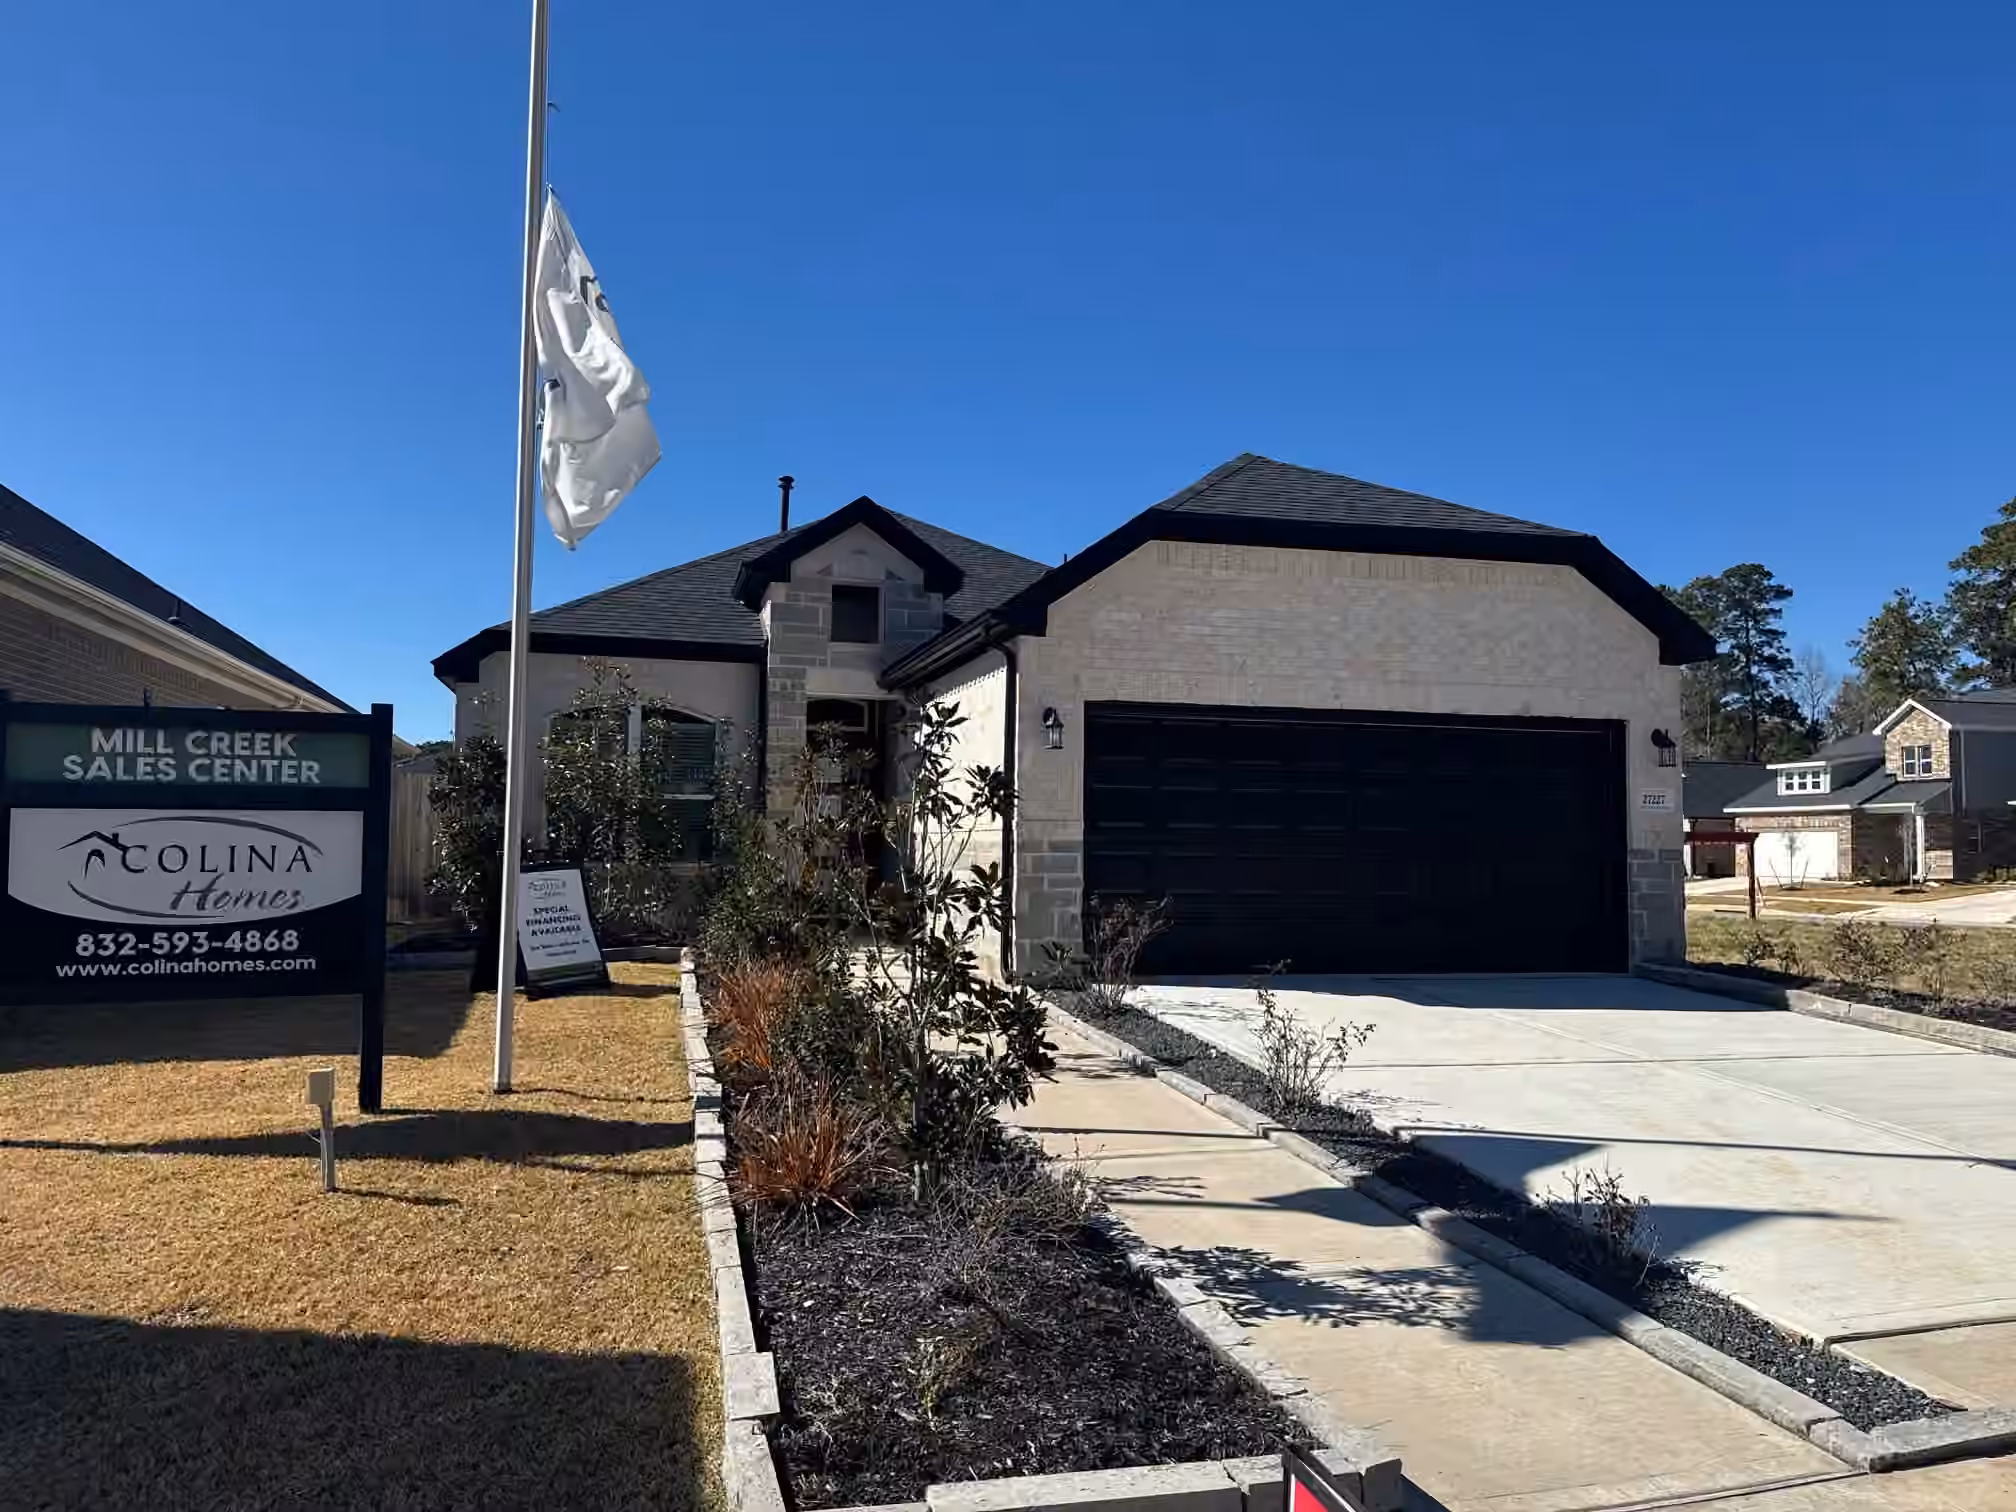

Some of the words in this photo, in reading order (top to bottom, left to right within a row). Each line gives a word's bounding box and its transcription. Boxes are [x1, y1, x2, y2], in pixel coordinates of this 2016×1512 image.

[91, 727, 174, 754] MILL
[184, 730, 297, 757] CREEK
[63, 755, 177, 781] SALES
[188, 756, 320, 784] CENTER
[120, 843, 313, 874] COLINA
[169, 873, 302, 911] Homes
[75, 929, 301, 957] 832-593-4868
[56, 956, 317, 978] www.colinahomes.com
